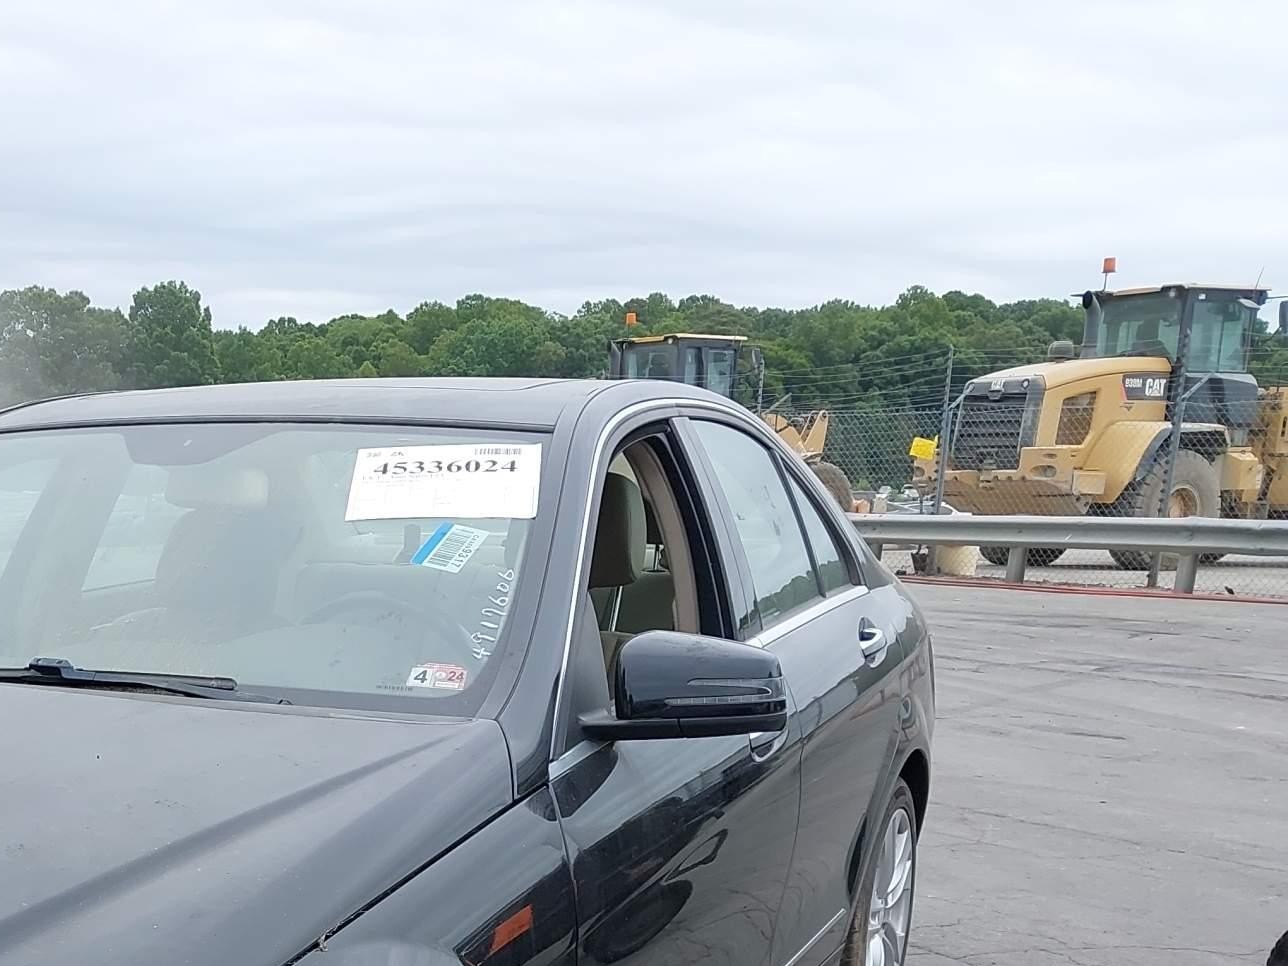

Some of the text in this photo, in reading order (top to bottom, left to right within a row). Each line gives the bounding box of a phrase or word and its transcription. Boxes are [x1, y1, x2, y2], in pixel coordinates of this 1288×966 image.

[1145, 378, 1167, 397] CAT
[373, 459, 518, 475] 45336024
[413, 669, 465, 684] 4 24
